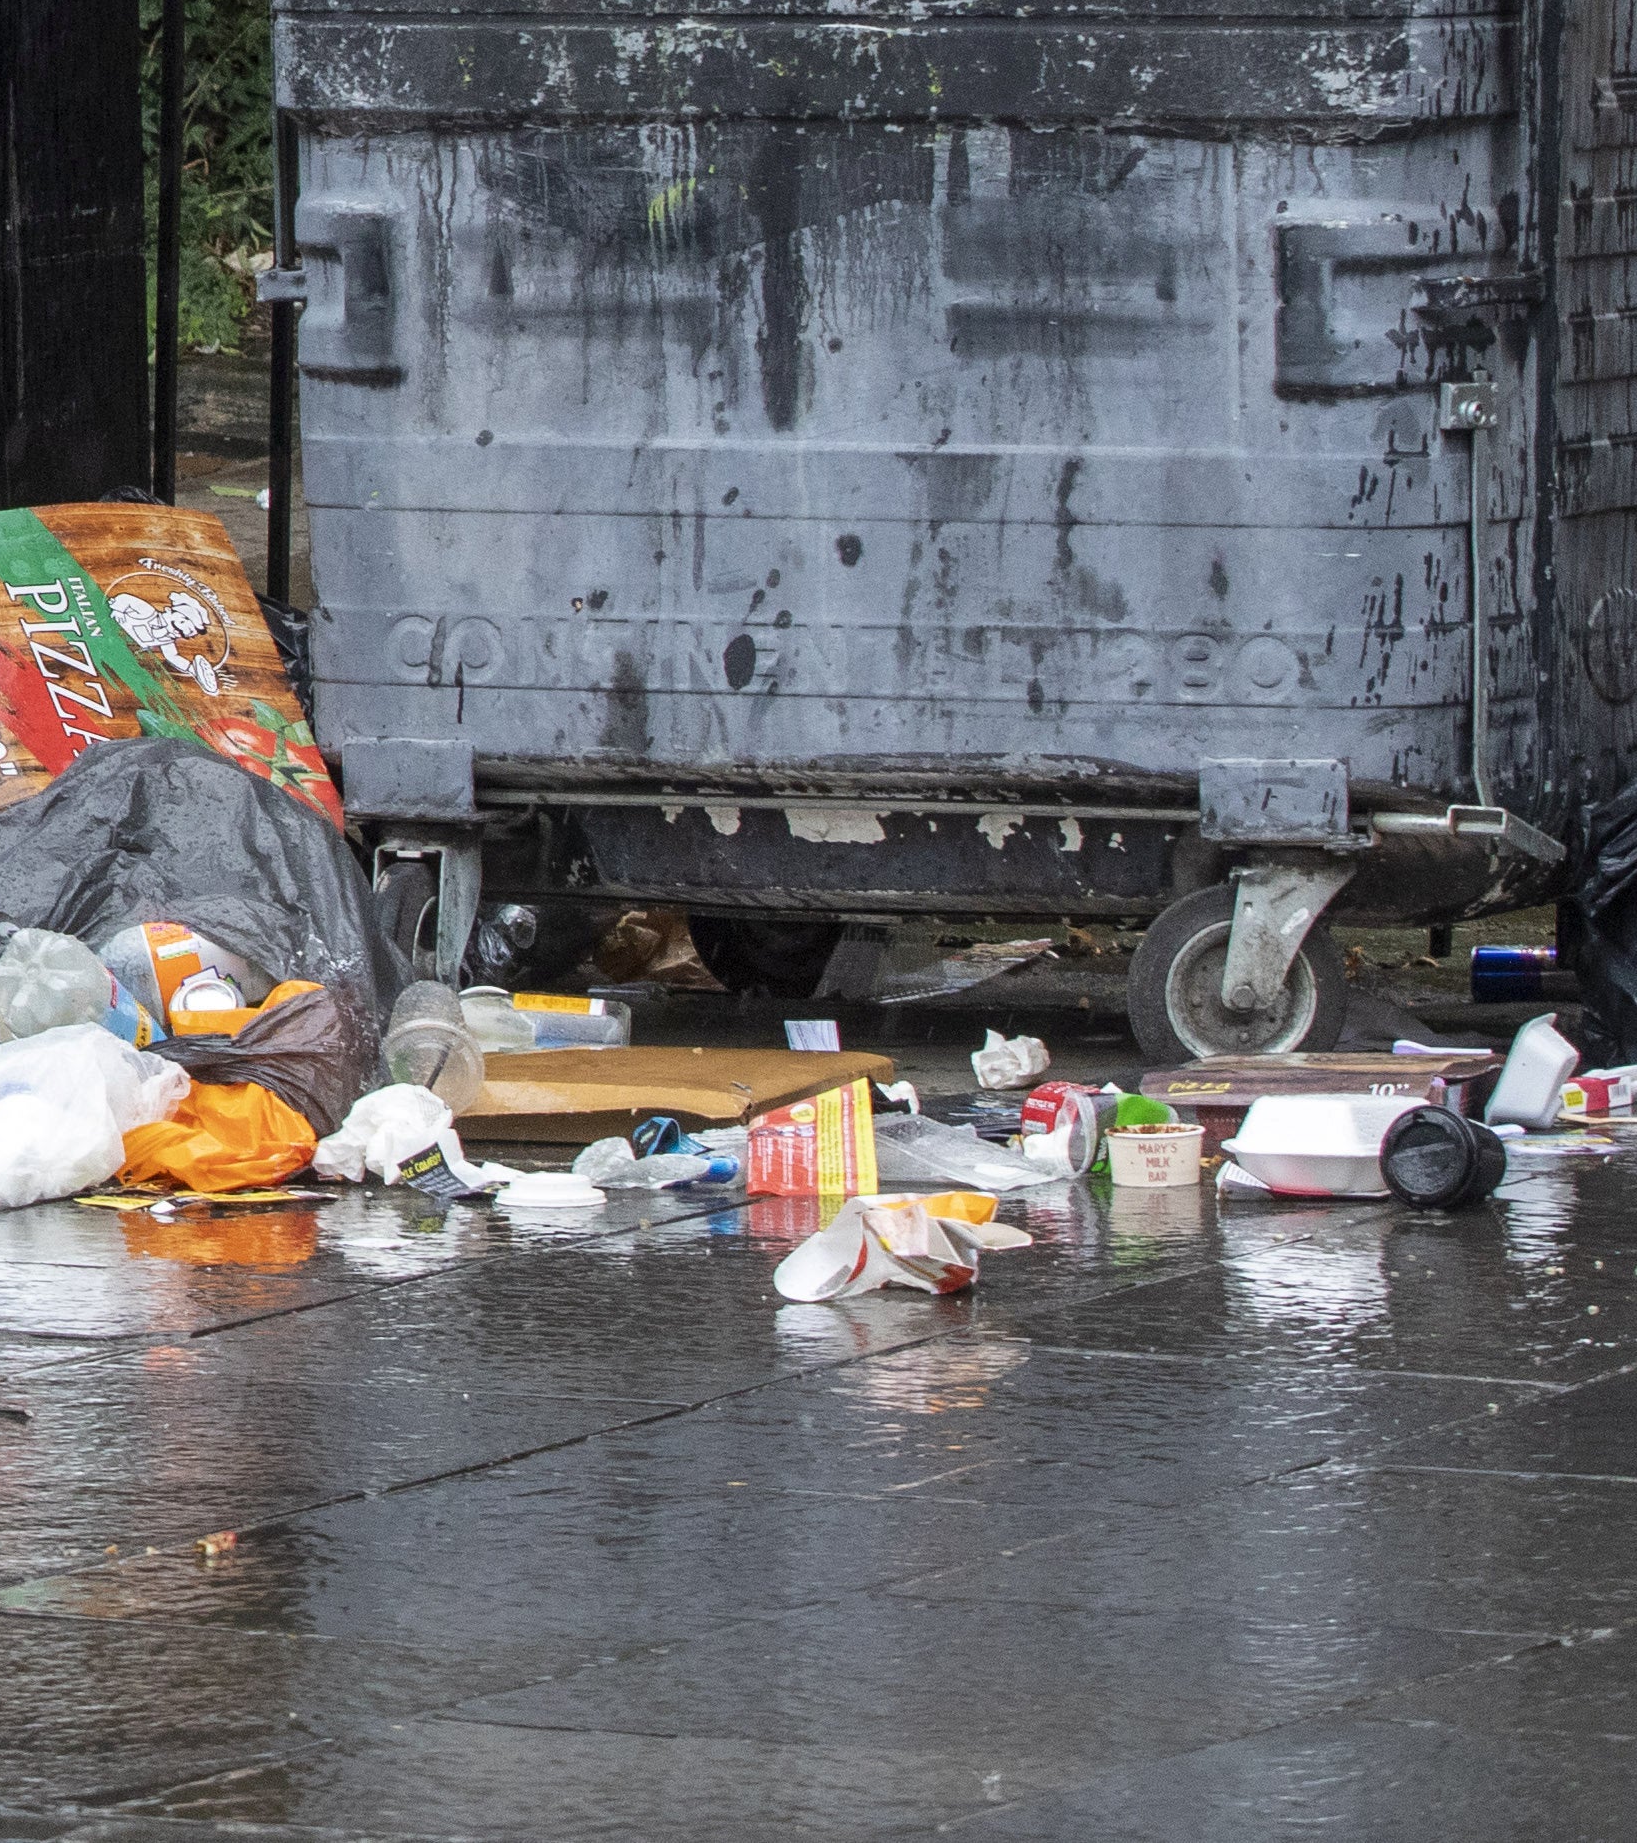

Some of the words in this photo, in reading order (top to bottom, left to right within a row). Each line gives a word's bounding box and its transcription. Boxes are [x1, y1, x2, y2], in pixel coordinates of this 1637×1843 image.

[138, 556, 196, 588] Freshly
[67, 576, 104, 639] ITALIAN
[1167, 1078, 1232, 1095] pizza
[1137, 1142, 1178, 1155] MARY'S
[1145, 1157, 1171, 1168] MILK
[1147, 1171, 1168, 1183] BAR
